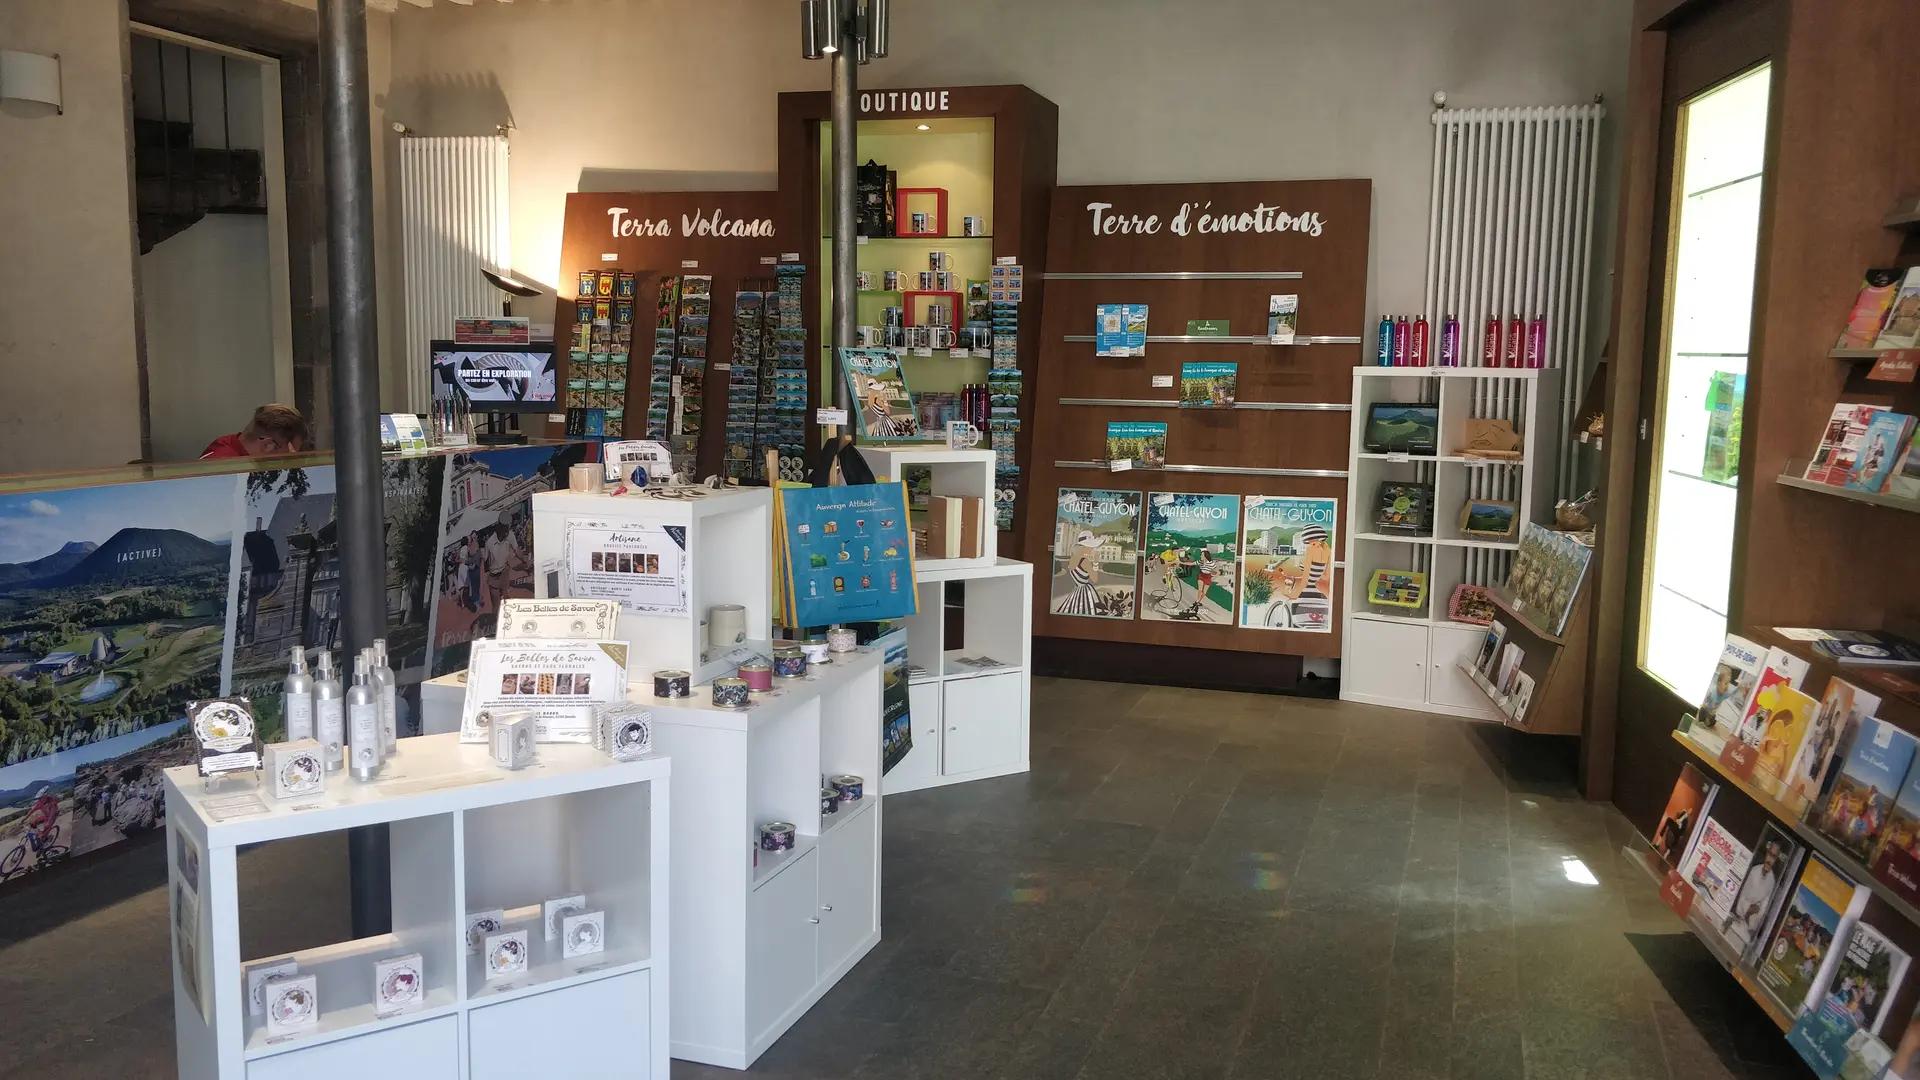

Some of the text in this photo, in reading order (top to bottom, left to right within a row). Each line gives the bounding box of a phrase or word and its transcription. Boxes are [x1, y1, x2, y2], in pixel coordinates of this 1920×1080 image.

[860, 91, 950, 113] OUTIQUE
[608, 207, 776, 238] Terra Volcana
[1087, 200, 1327, 237] Terre d'émotions
[458, 369, 480, 377] PARTEZ
[491, 370, 531, 378] EXPLORATION
[609, 533, 641, 543] Artisane
[117, 547, 161, 563] [ACTIVE]
[533, 604, 558, 612] Belles
[560, 604, 569, 612] de
[571, 604, 596, 612] Savon
[501, 653, 597, 663] Les Belles de Savon
